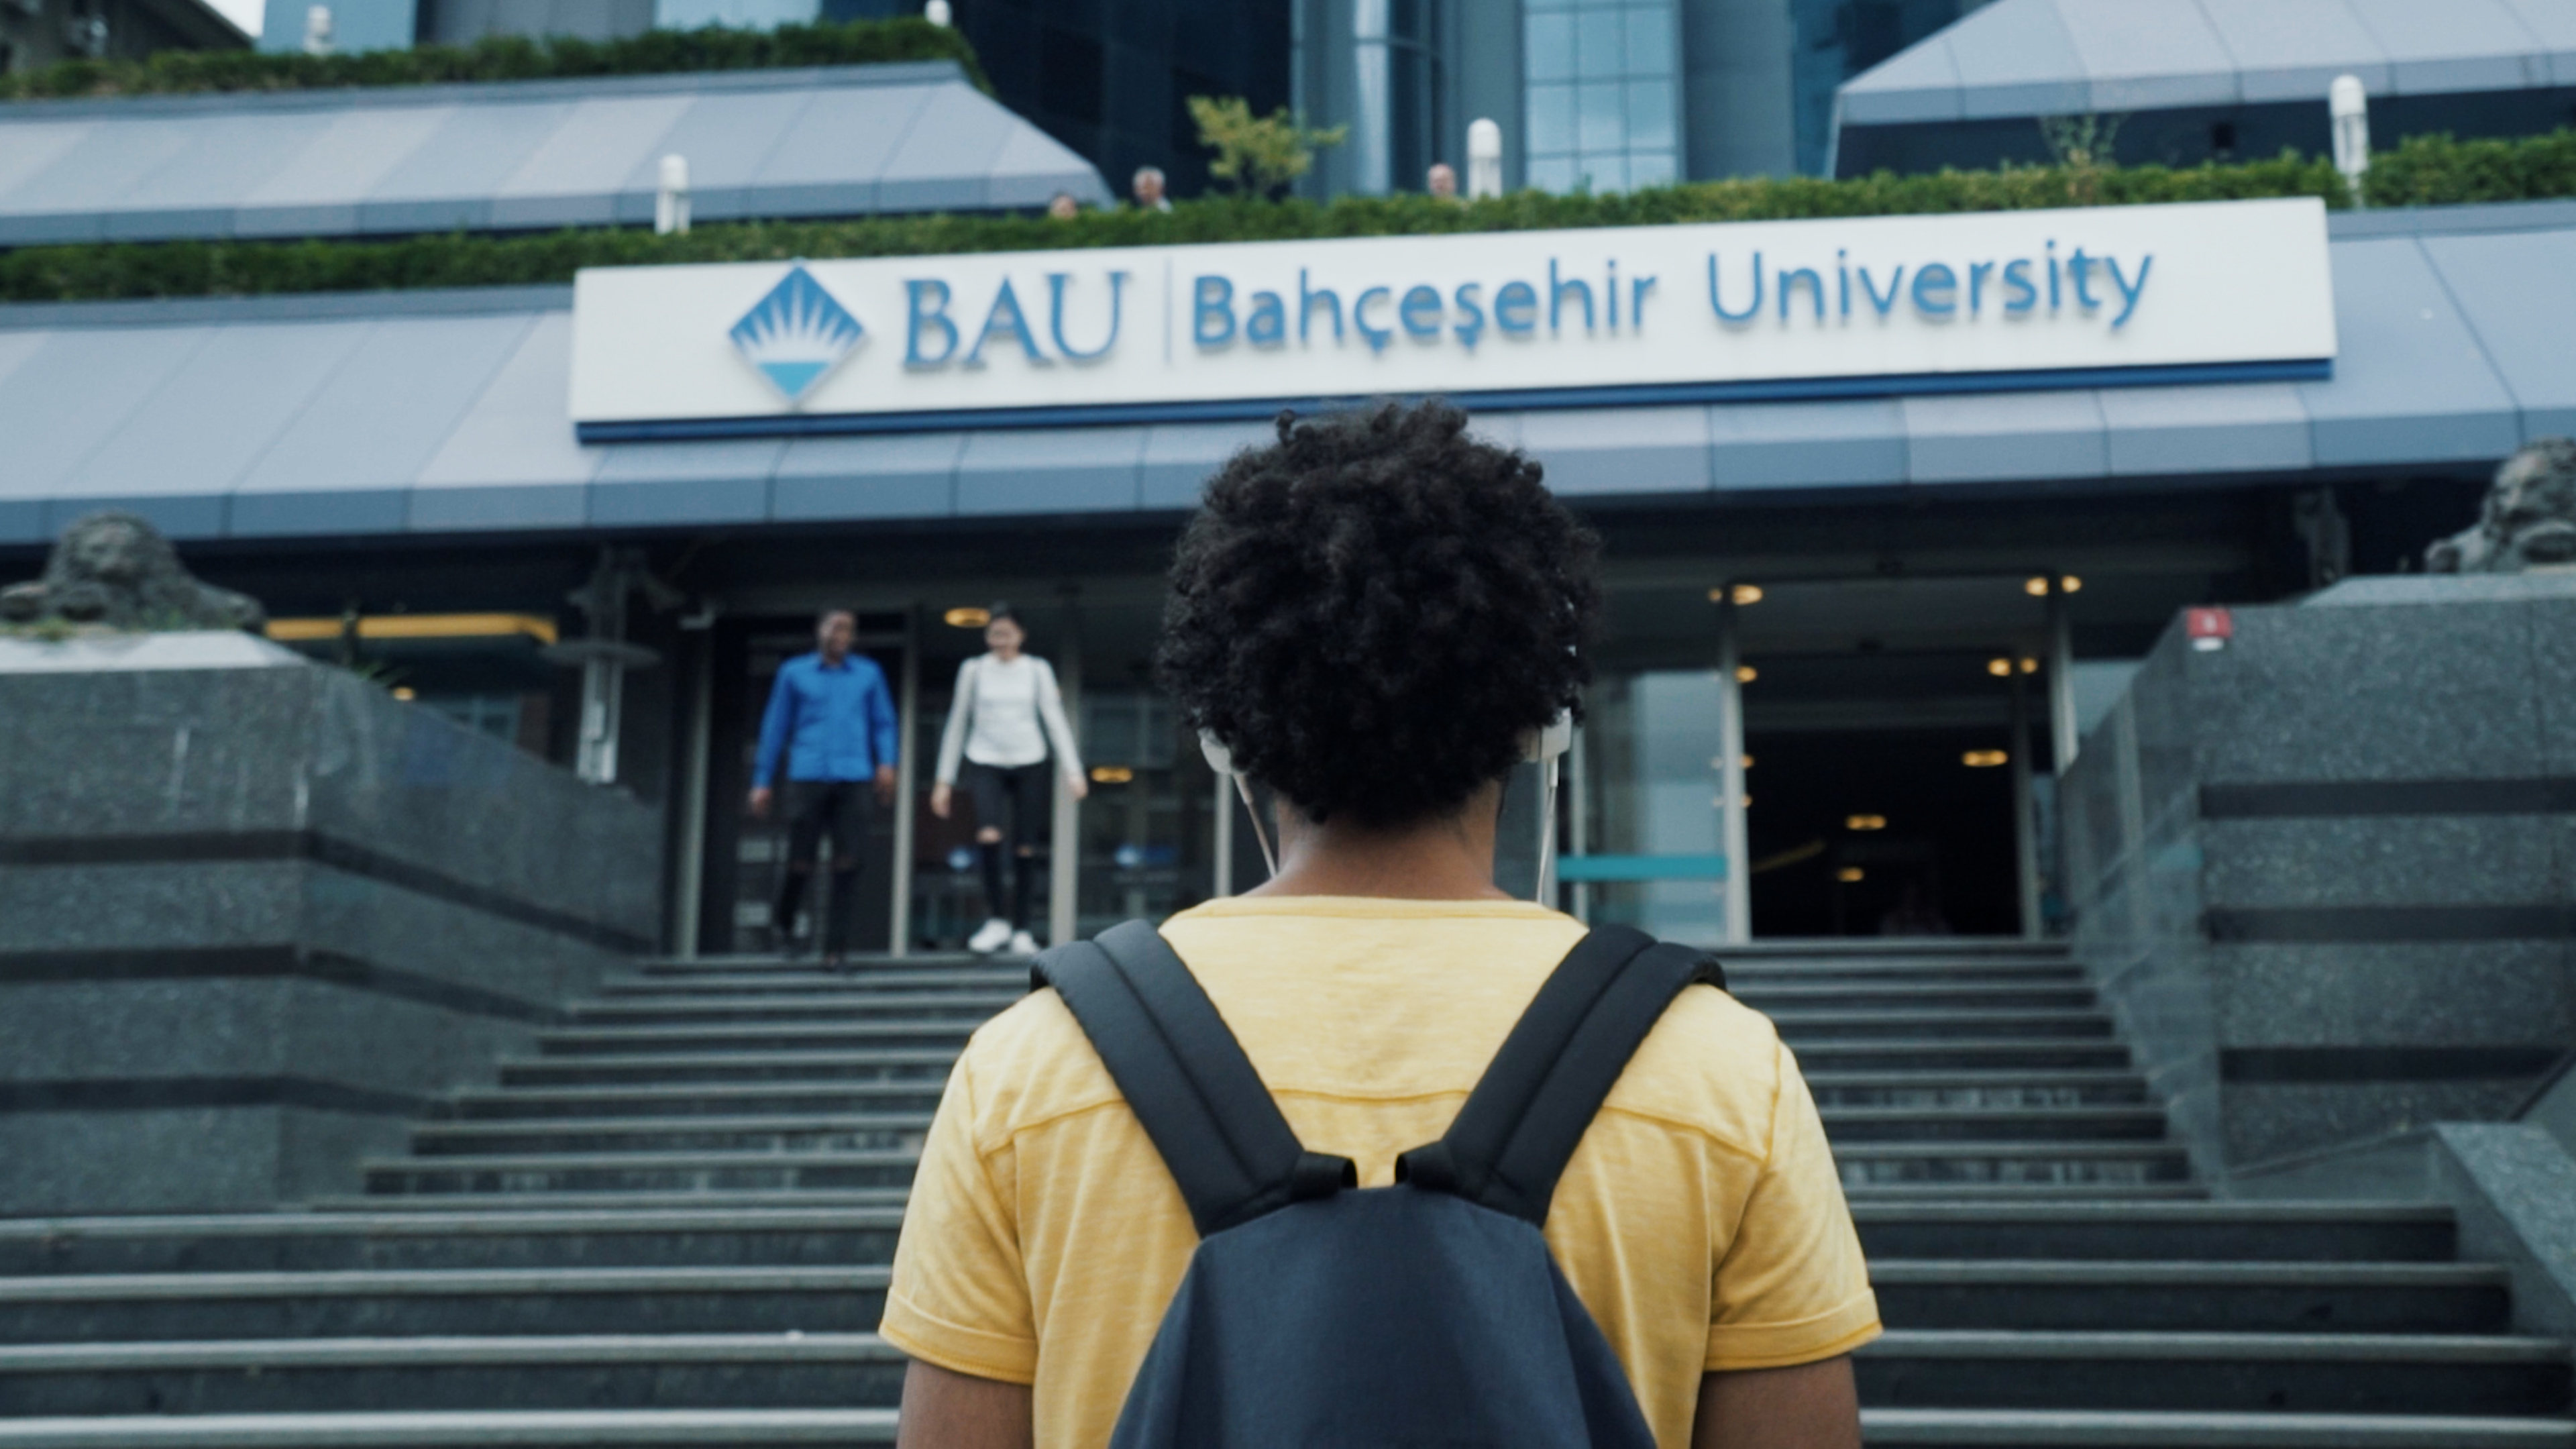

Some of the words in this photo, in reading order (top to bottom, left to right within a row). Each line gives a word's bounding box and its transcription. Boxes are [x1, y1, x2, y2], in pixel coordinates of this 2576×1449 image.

[903, 270, 1132, 368] BAU
[1192, 258, 1658, 354] Bahçeşehir
[1708, 238, 2153, 329] University
